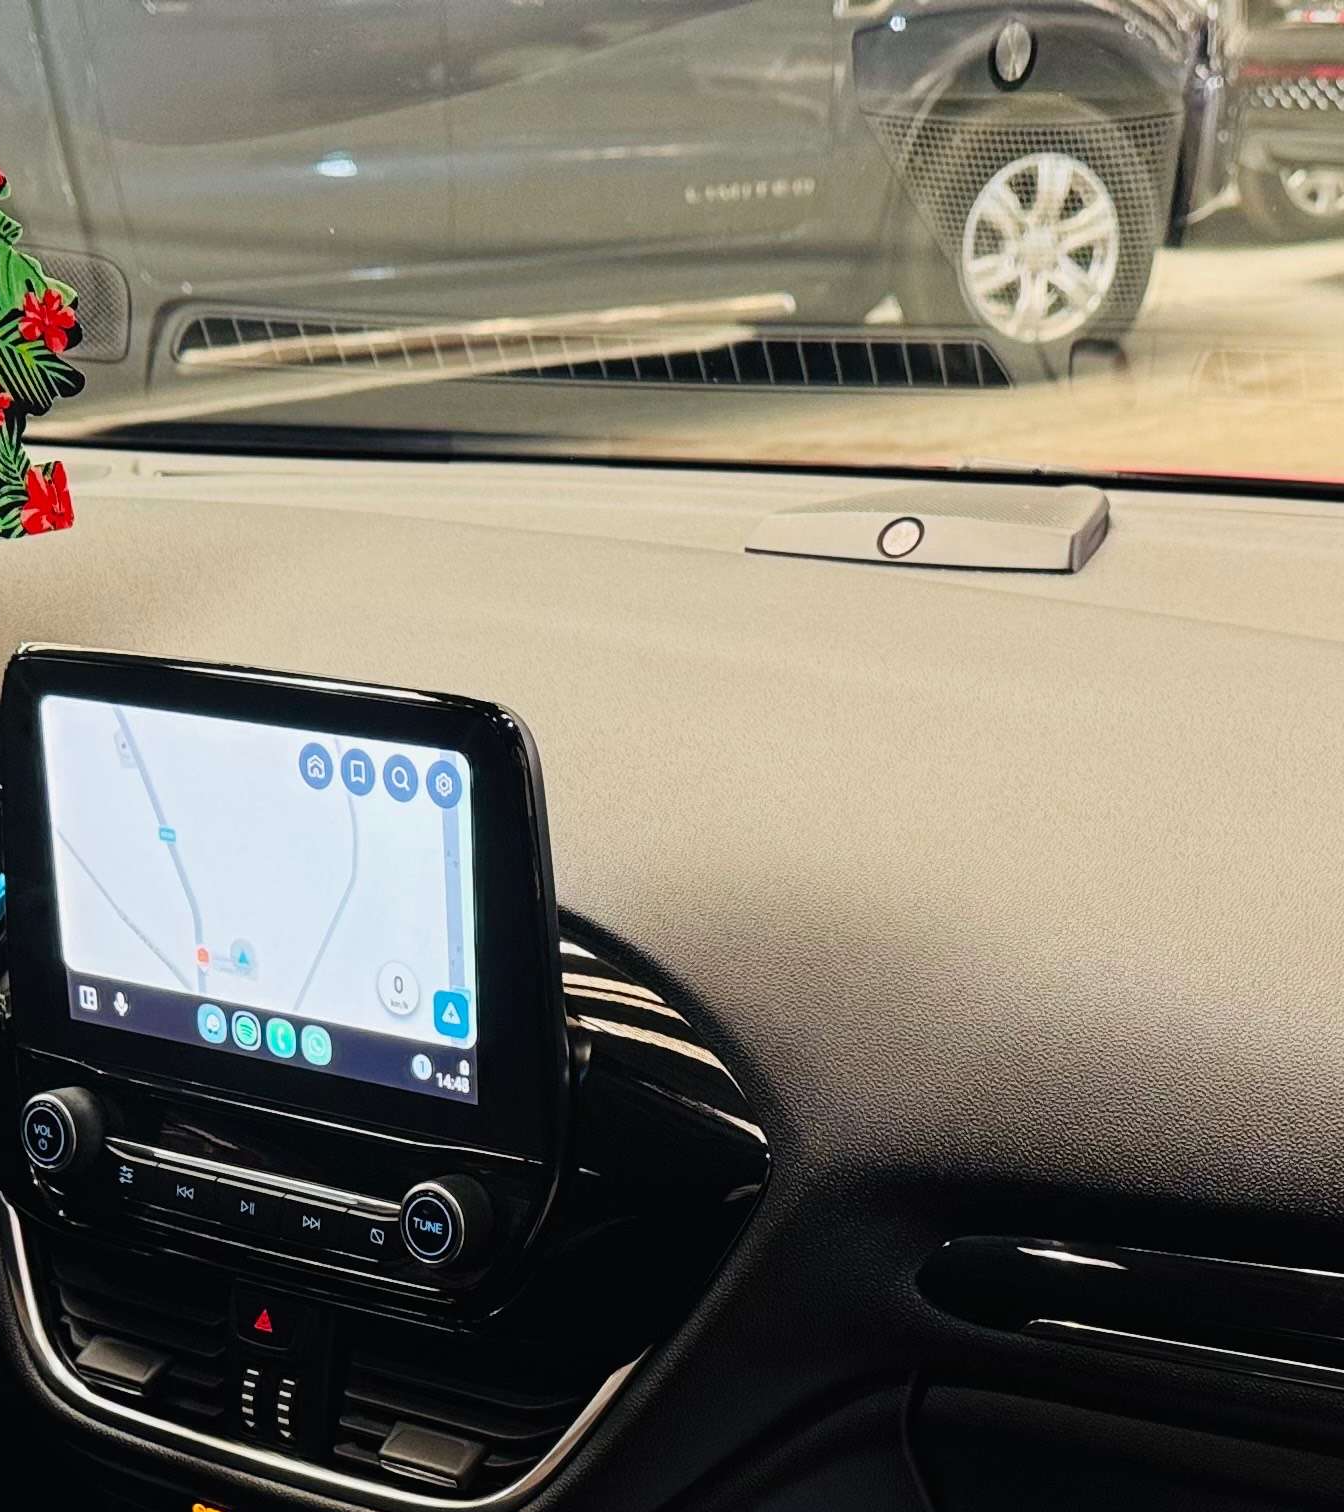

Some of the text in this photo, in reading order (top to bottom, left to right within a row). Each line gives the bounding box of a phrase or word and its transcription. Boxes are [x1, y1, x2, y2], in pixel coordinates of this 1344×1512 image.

[393, 975, 404, 994] 0
[32, 1124, 53, 1140] VOL
[413, 1218, 443, 1236] TUNE
